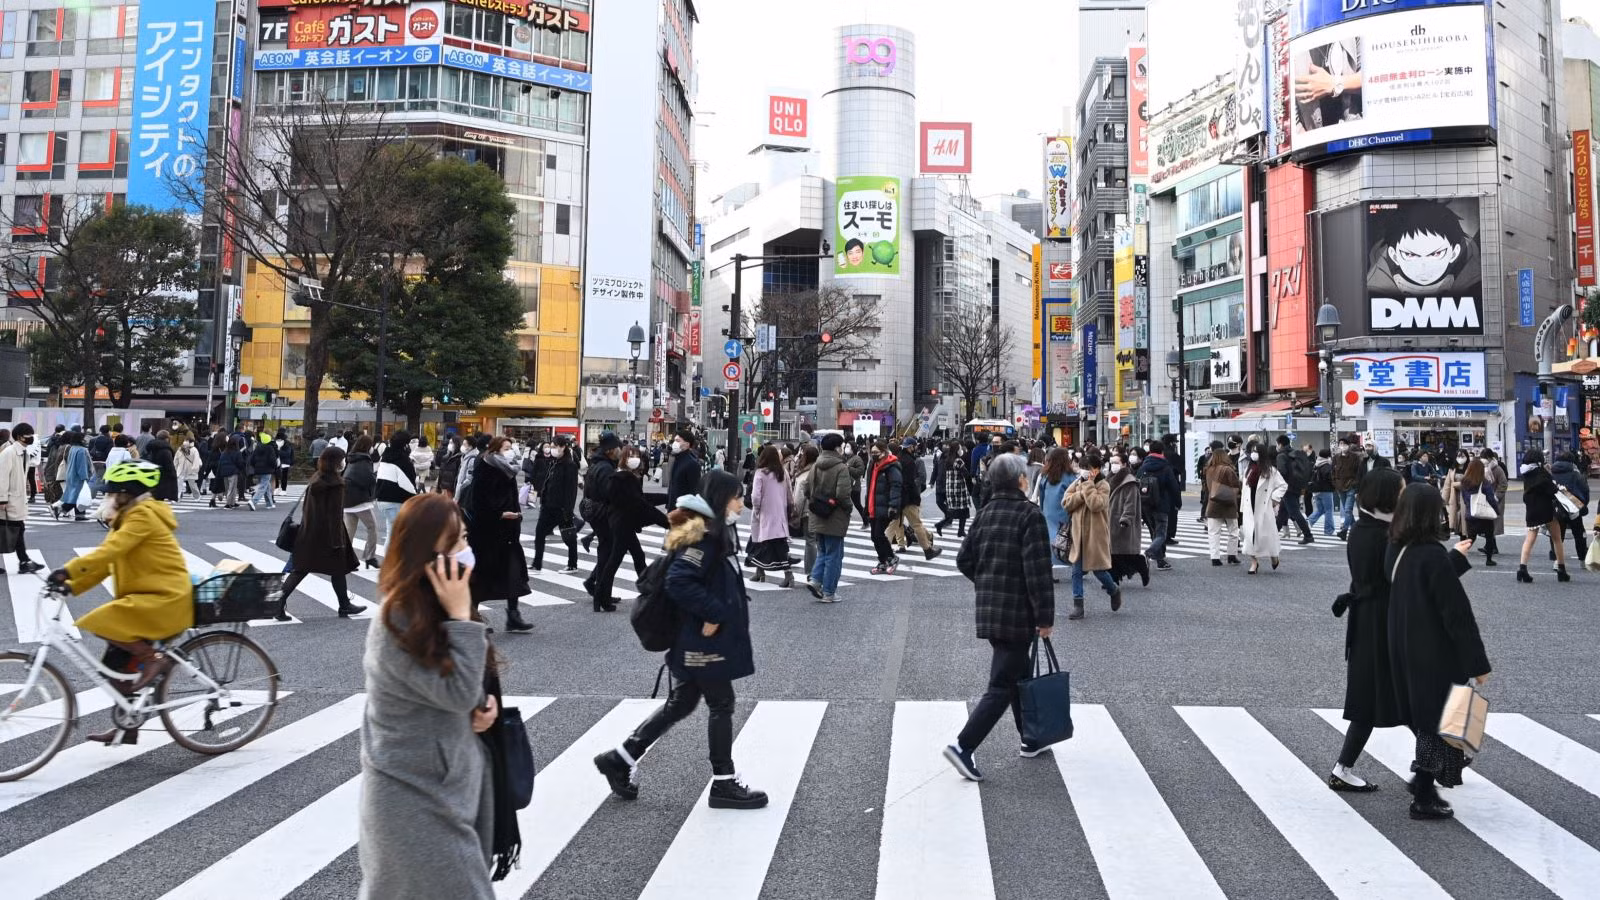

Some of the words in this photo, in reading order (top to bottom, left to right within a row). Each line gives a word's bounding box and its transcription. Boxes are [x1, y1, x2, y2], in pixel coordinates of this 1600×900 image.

[527, 3, 579, 31] ガスト
[262, 22, 289, 40] 7F
[295, 20, 325, 33] Café
[327, 14, 399, 45] ガスト
[412, 22, 435, 31] ガスト
[295, 34, 324, 43] レストラン
[1371, 34, 1469, 52] HOUSEKIHIROBA
[260, 53, 294, 65] AEON
[305, 49, 408, 66] 英会話イーオン
[416, 49, 430, 60] 6F
[845, 36, 896, 76] 109
[449, 50, 483, 66] AEON
[493, 57, 588, 87] 英会話イーオン
[139, 21, 177, 178] アイシティ
[173, 20, 204, 178] コンタクトの
[774, 101, 800, 115] UNI
[774, 117, 803, 133] QLO
[933, 138, 959, 156] H&M
[1348, 138, 1367, 148] DHC
[1368, 133, 1404, 145] Channel
[1576, 135, 1589, 219] クスリのことなら
[843, 200, 893, 210] 住まい探しは
[843, 211, 893, 230] スーモ
[1578, 225, 1594, 278] 三千里
[592, 277, 644, 290] ツツミプロジェクト
[1180, 266, 1224, 286] Euphoria
[592, 287, 644, 300] デザイン製作中
[1371, 297, 1480, 328] DMM
[1354, 360, 1472, 388] 堂書店
